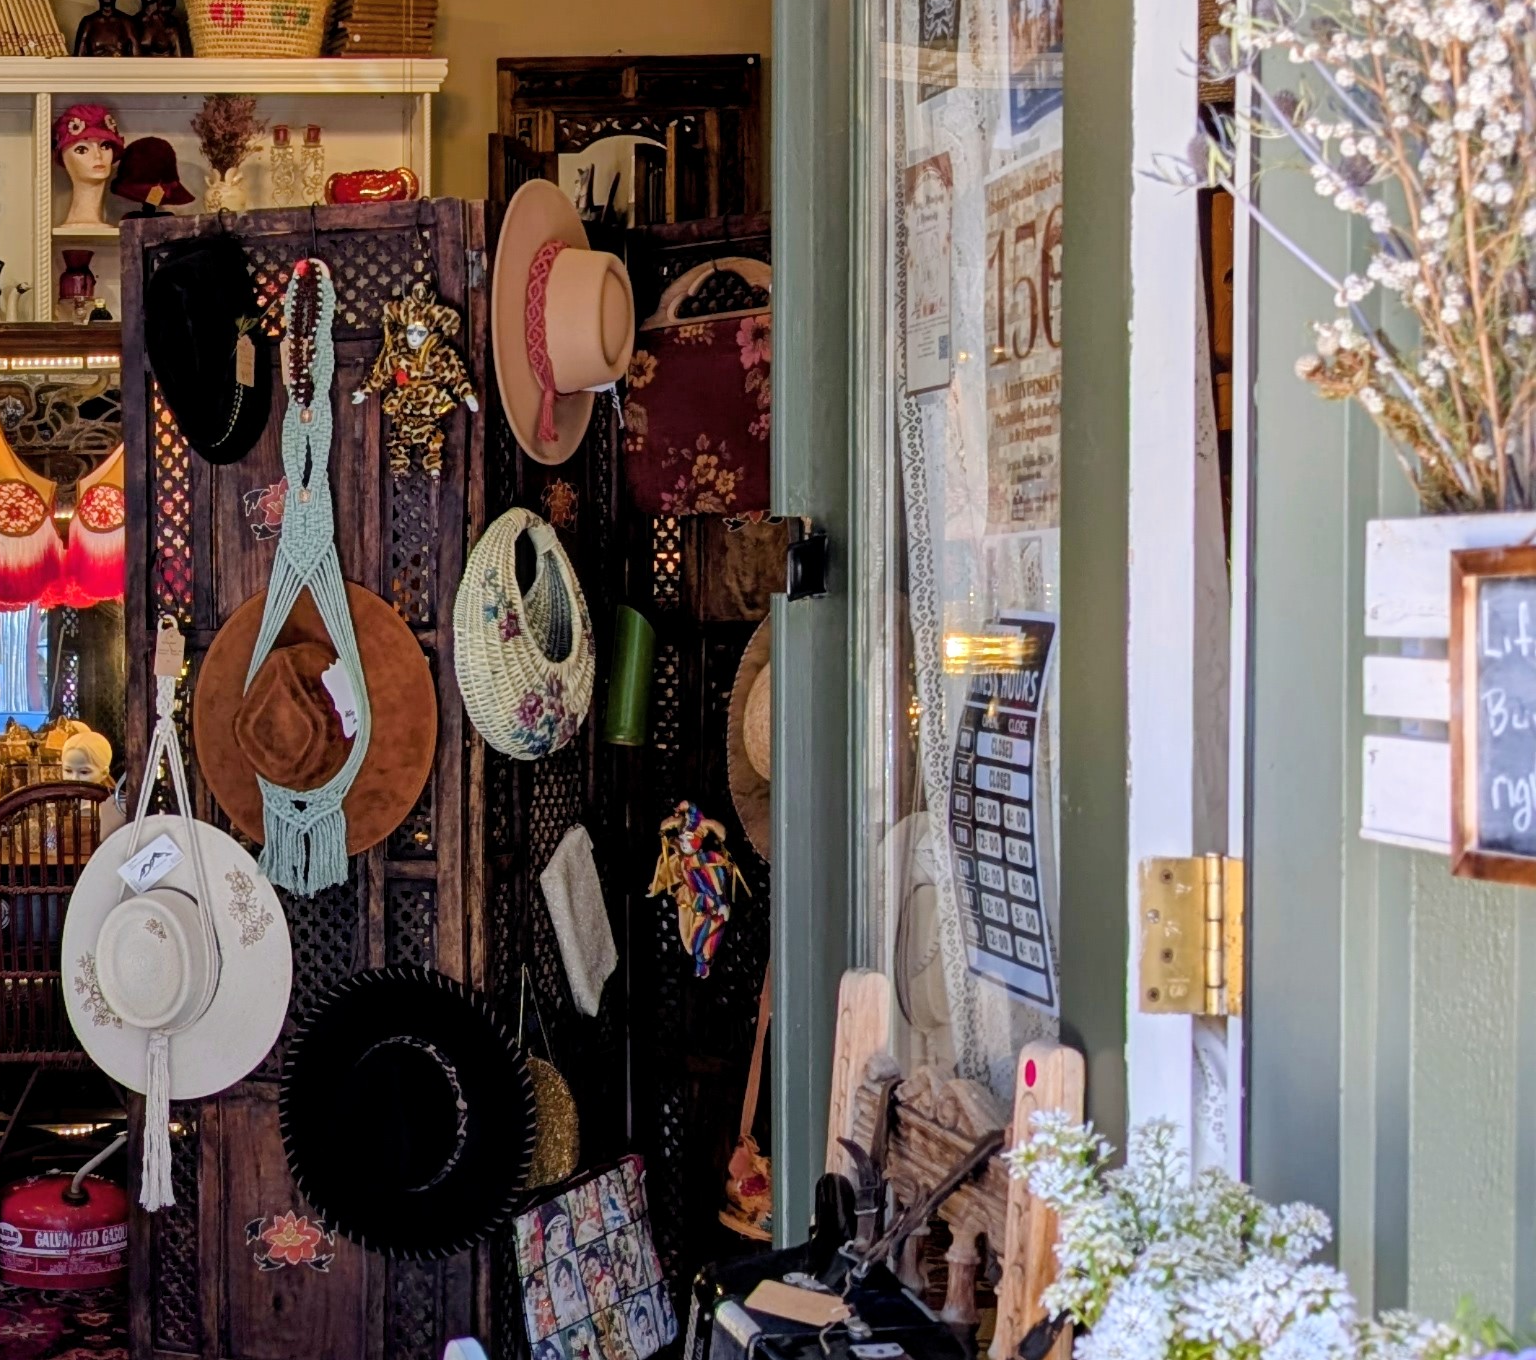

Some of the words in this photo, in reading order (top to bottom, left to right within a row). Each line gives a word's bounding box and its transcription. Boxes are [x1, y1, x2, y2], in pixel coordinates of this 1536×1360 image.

[1481, 600, 1536, 658] Lif
[1000, 669, 1039, 703] HOURS
[1008, 718, 1028, 736] CLOSE
[991, 736, 1013, 760] CLOSED
[989, 770, 1011, 792] CLOSED
[35, 1230, 100, 1248] GALVANIZED
